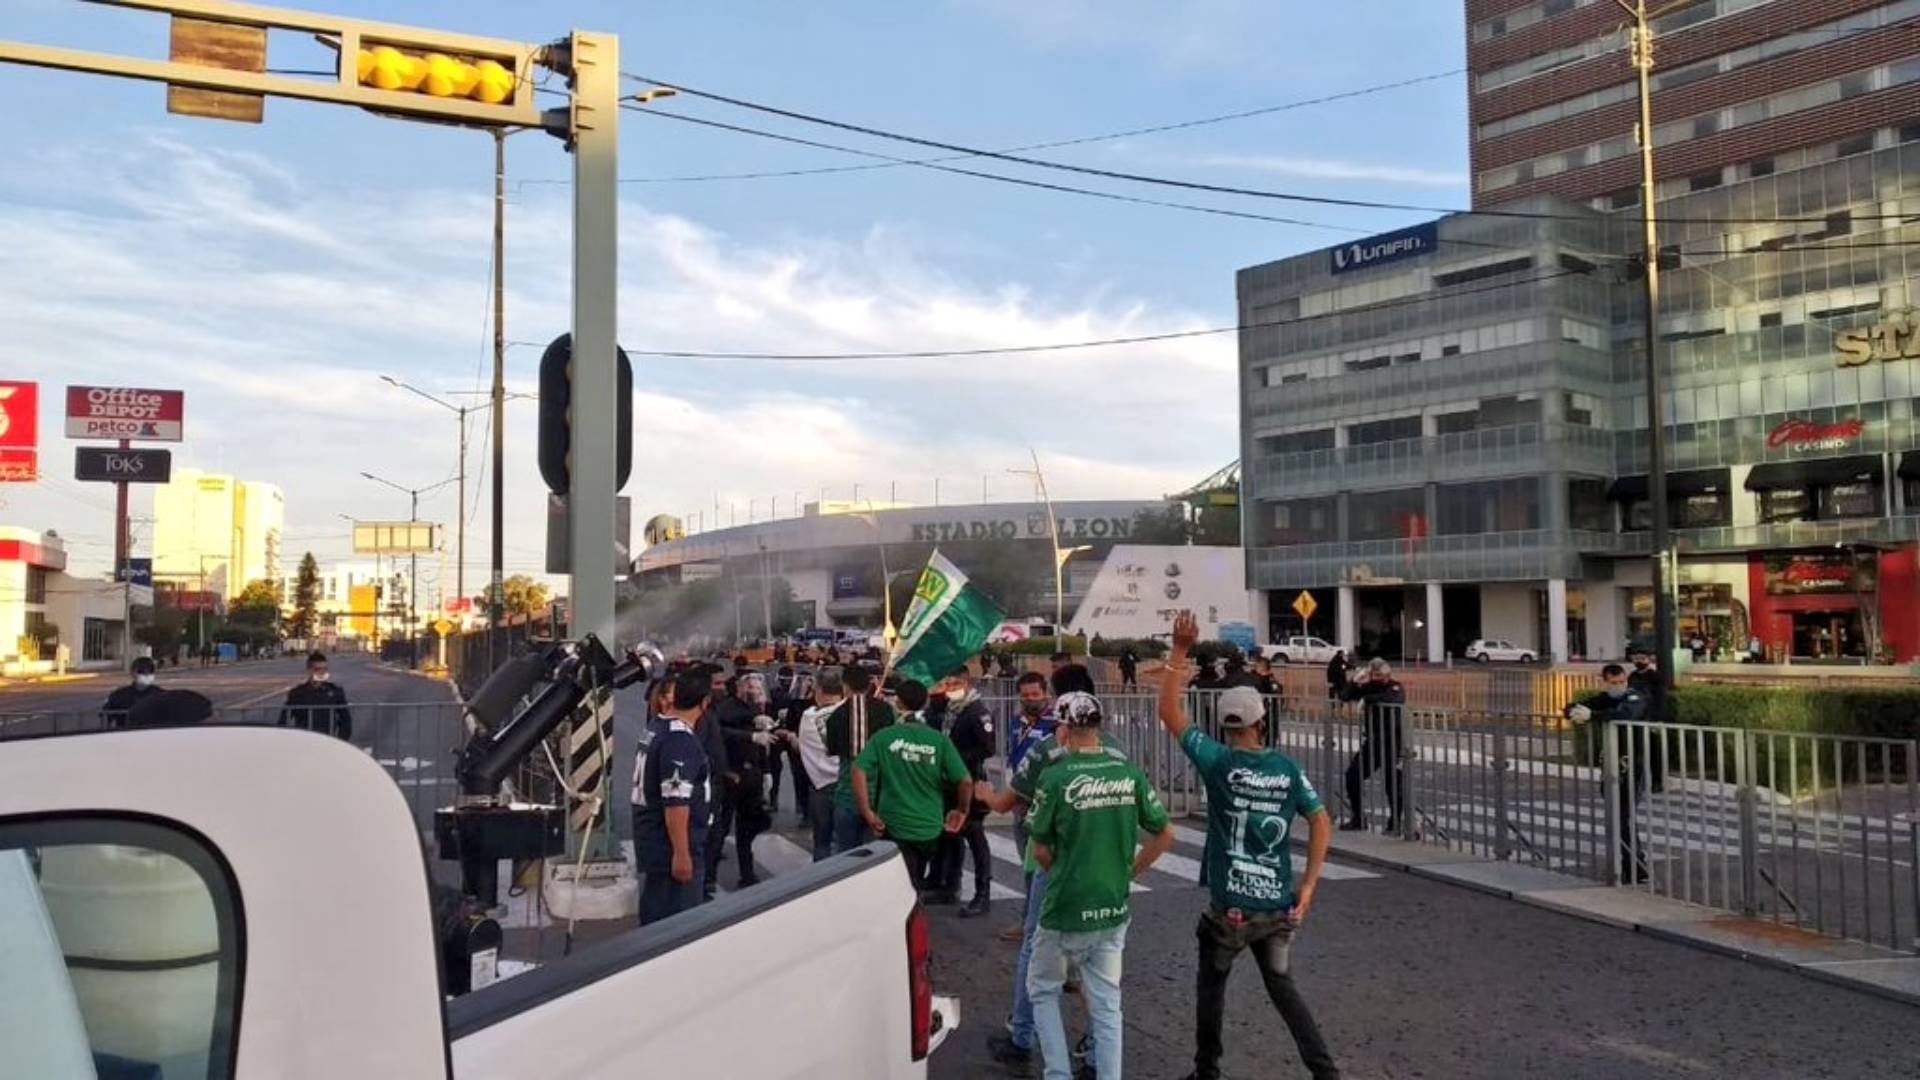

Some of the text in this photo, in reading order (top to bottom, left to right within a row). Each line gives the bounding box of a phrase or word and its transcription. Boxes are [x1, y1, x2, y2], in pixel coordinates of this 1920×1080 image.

[1834, 322, 1920, 368] ST
[87, 387, 162, 407] Office
[90, 403, 161, 418] DEPOT
[87, 419, 138, 434] petco
[911, 517, 1128, 542] ESTADIO LEON
[1065, 774, 1135, 803] Caliente
[1227, 768, 1291, 789] Caliente
[1225, 810, 1288, 868] 12
